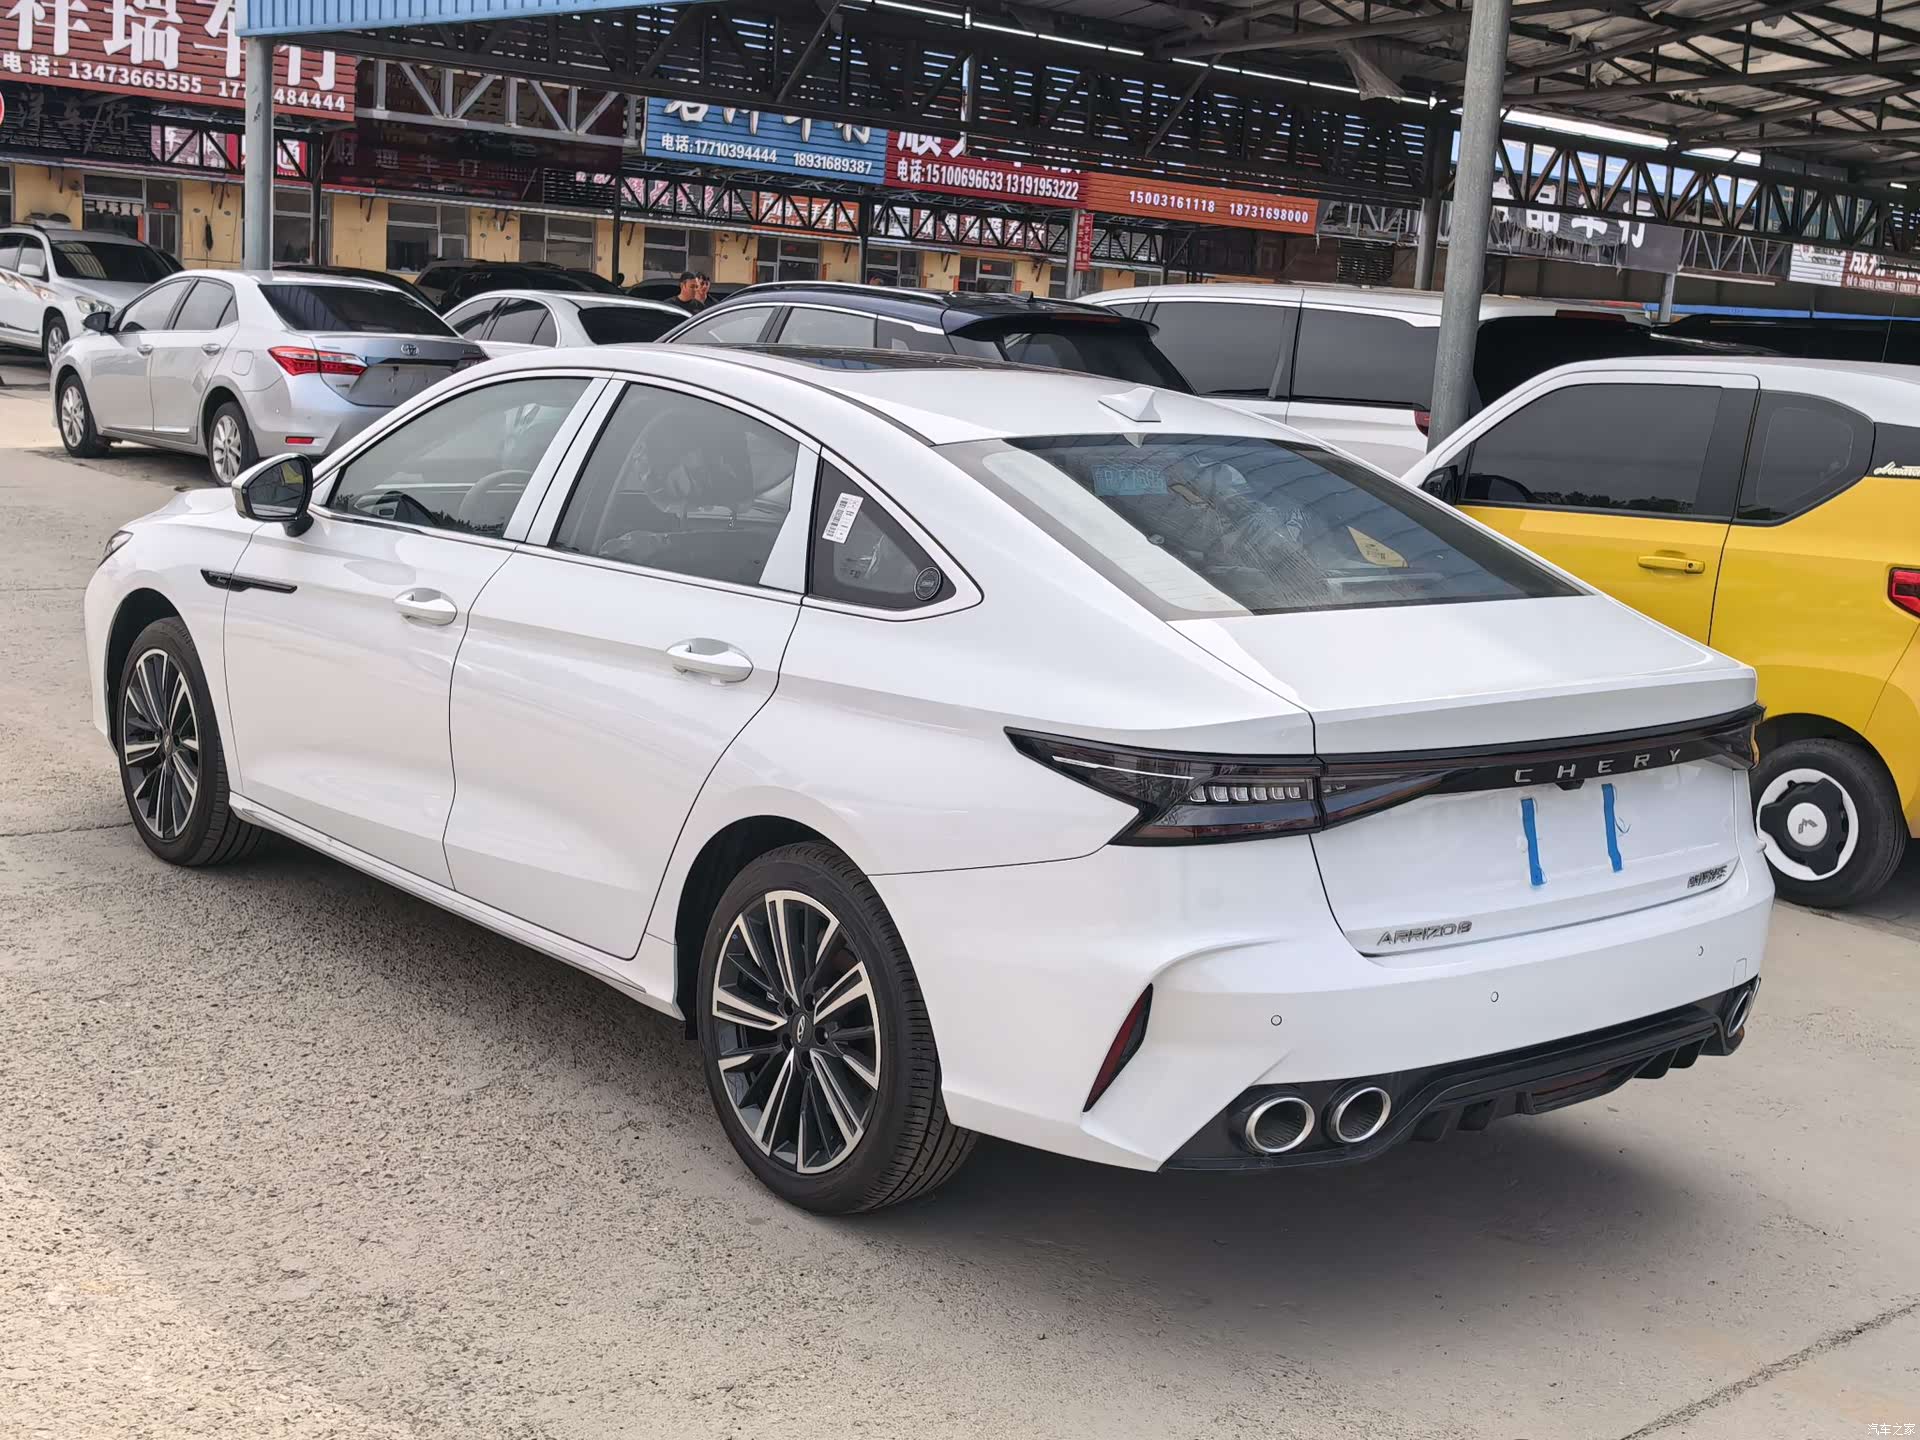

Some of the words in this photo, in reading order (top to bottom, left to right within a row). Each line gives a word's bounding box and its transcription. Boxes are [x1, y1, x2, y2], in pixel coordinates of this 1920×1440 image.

[68, 61, 202, 94] 13473665555
[793, 151, 873, 175] 18931689387
[1006, 173, 1080, 200] 13191953222
[1129, 190, 1215, 213] 15003161118
[1229, 203, 1309, 224] 18731698000
[1515, 748, 1680, 783] CHERY
